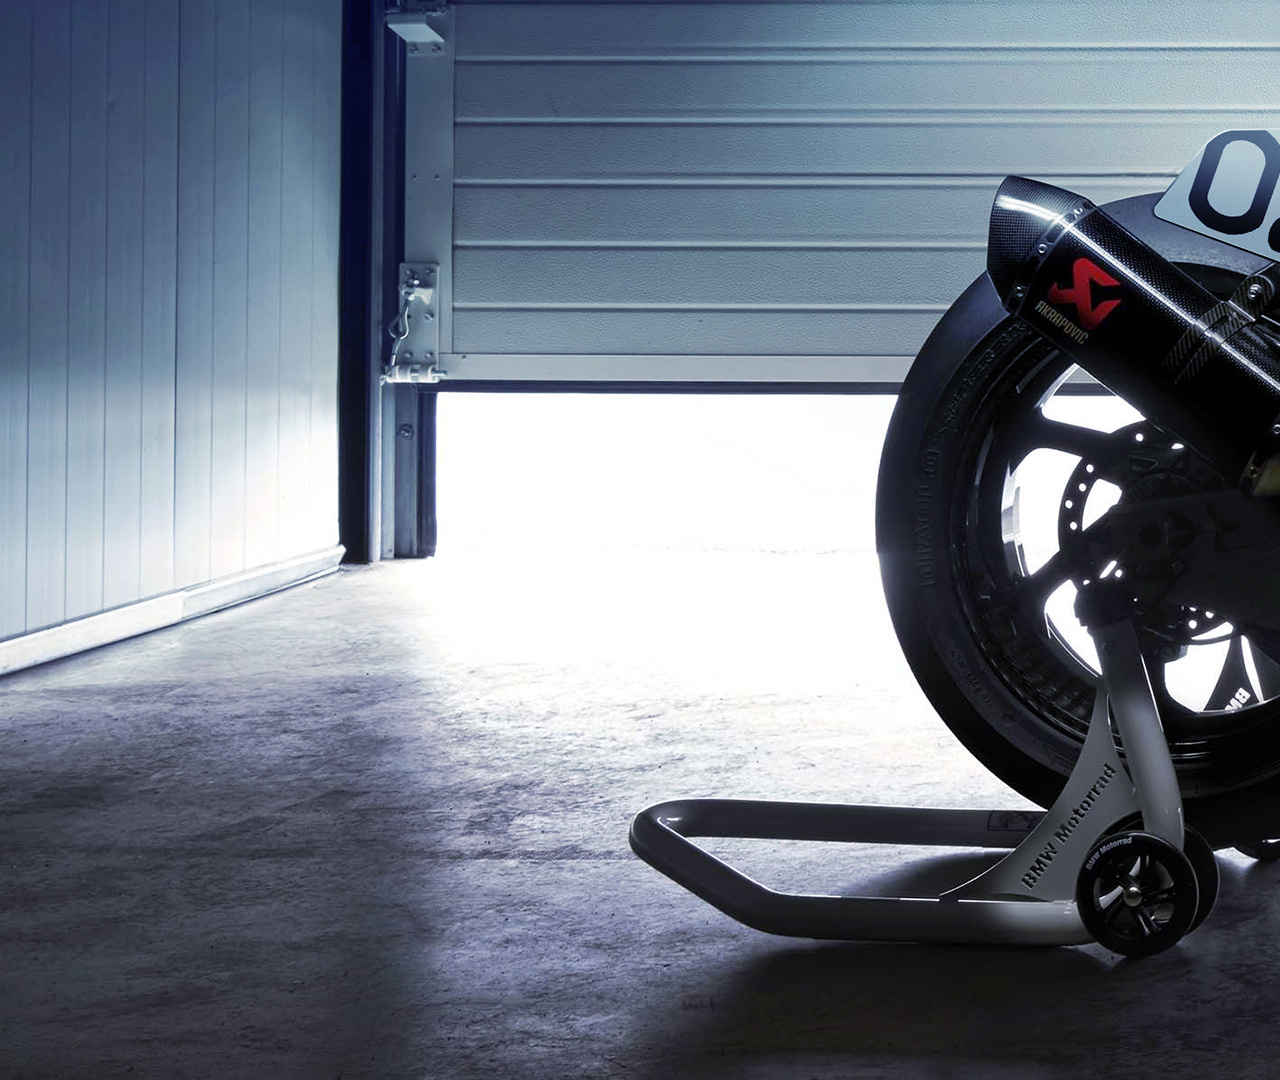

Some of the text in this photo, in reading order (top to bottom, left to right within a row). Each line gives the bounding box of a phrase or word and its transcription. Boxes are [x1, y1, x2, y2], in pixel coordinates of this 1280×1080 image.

[1034, 299, 1090, 345] AKRAPOVIC
[1021, 763, 1117, 890] BMW Motorrad
[1085, 836, 1133, 871] BMW Motorrad
